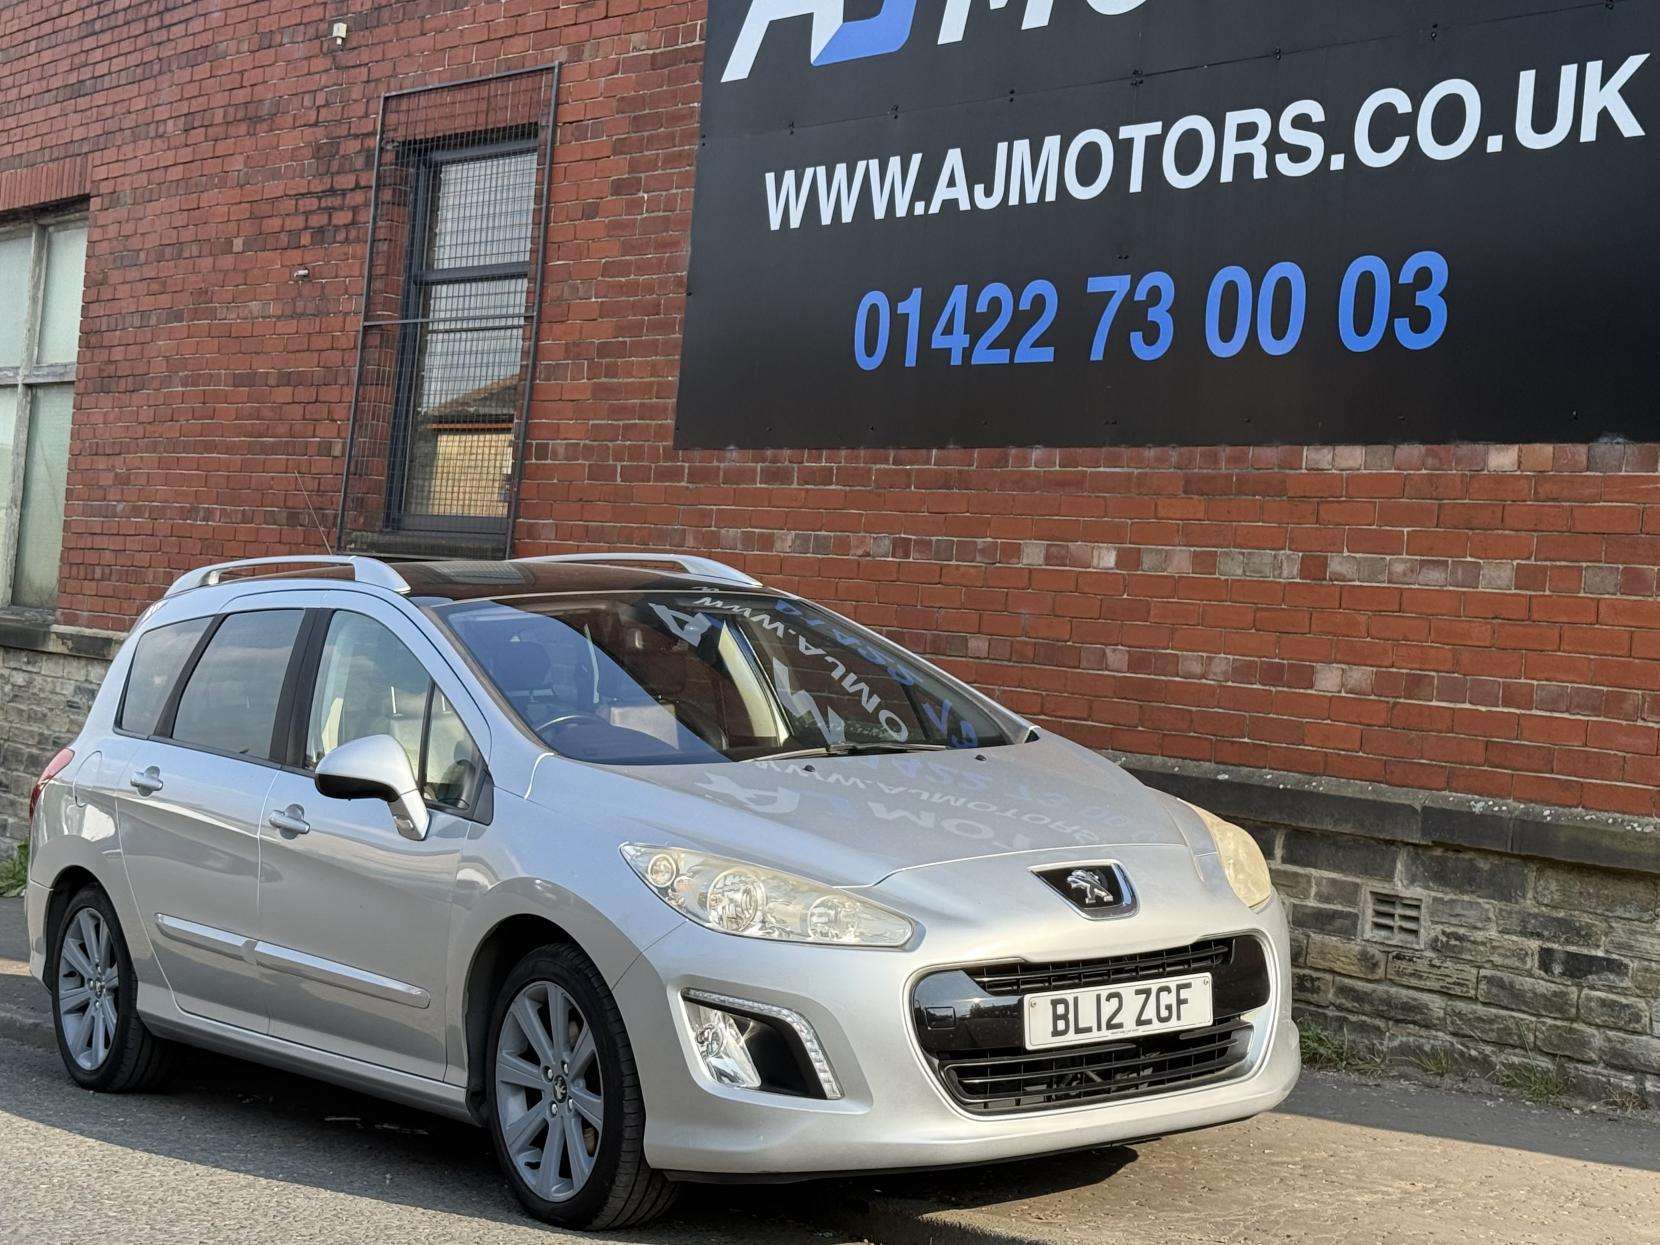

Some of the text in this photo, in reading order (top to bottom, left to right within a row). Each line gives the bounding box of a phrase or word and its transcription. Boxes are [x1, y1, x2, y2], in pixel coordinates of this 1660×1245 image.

[764, 53, 1651, 231] WWW.AJMOTORS.CO.UK
[854, 250, 1449, 371] 01422 73 00 03
[1050, 982, 1193, 1038] BL12 ZGF
